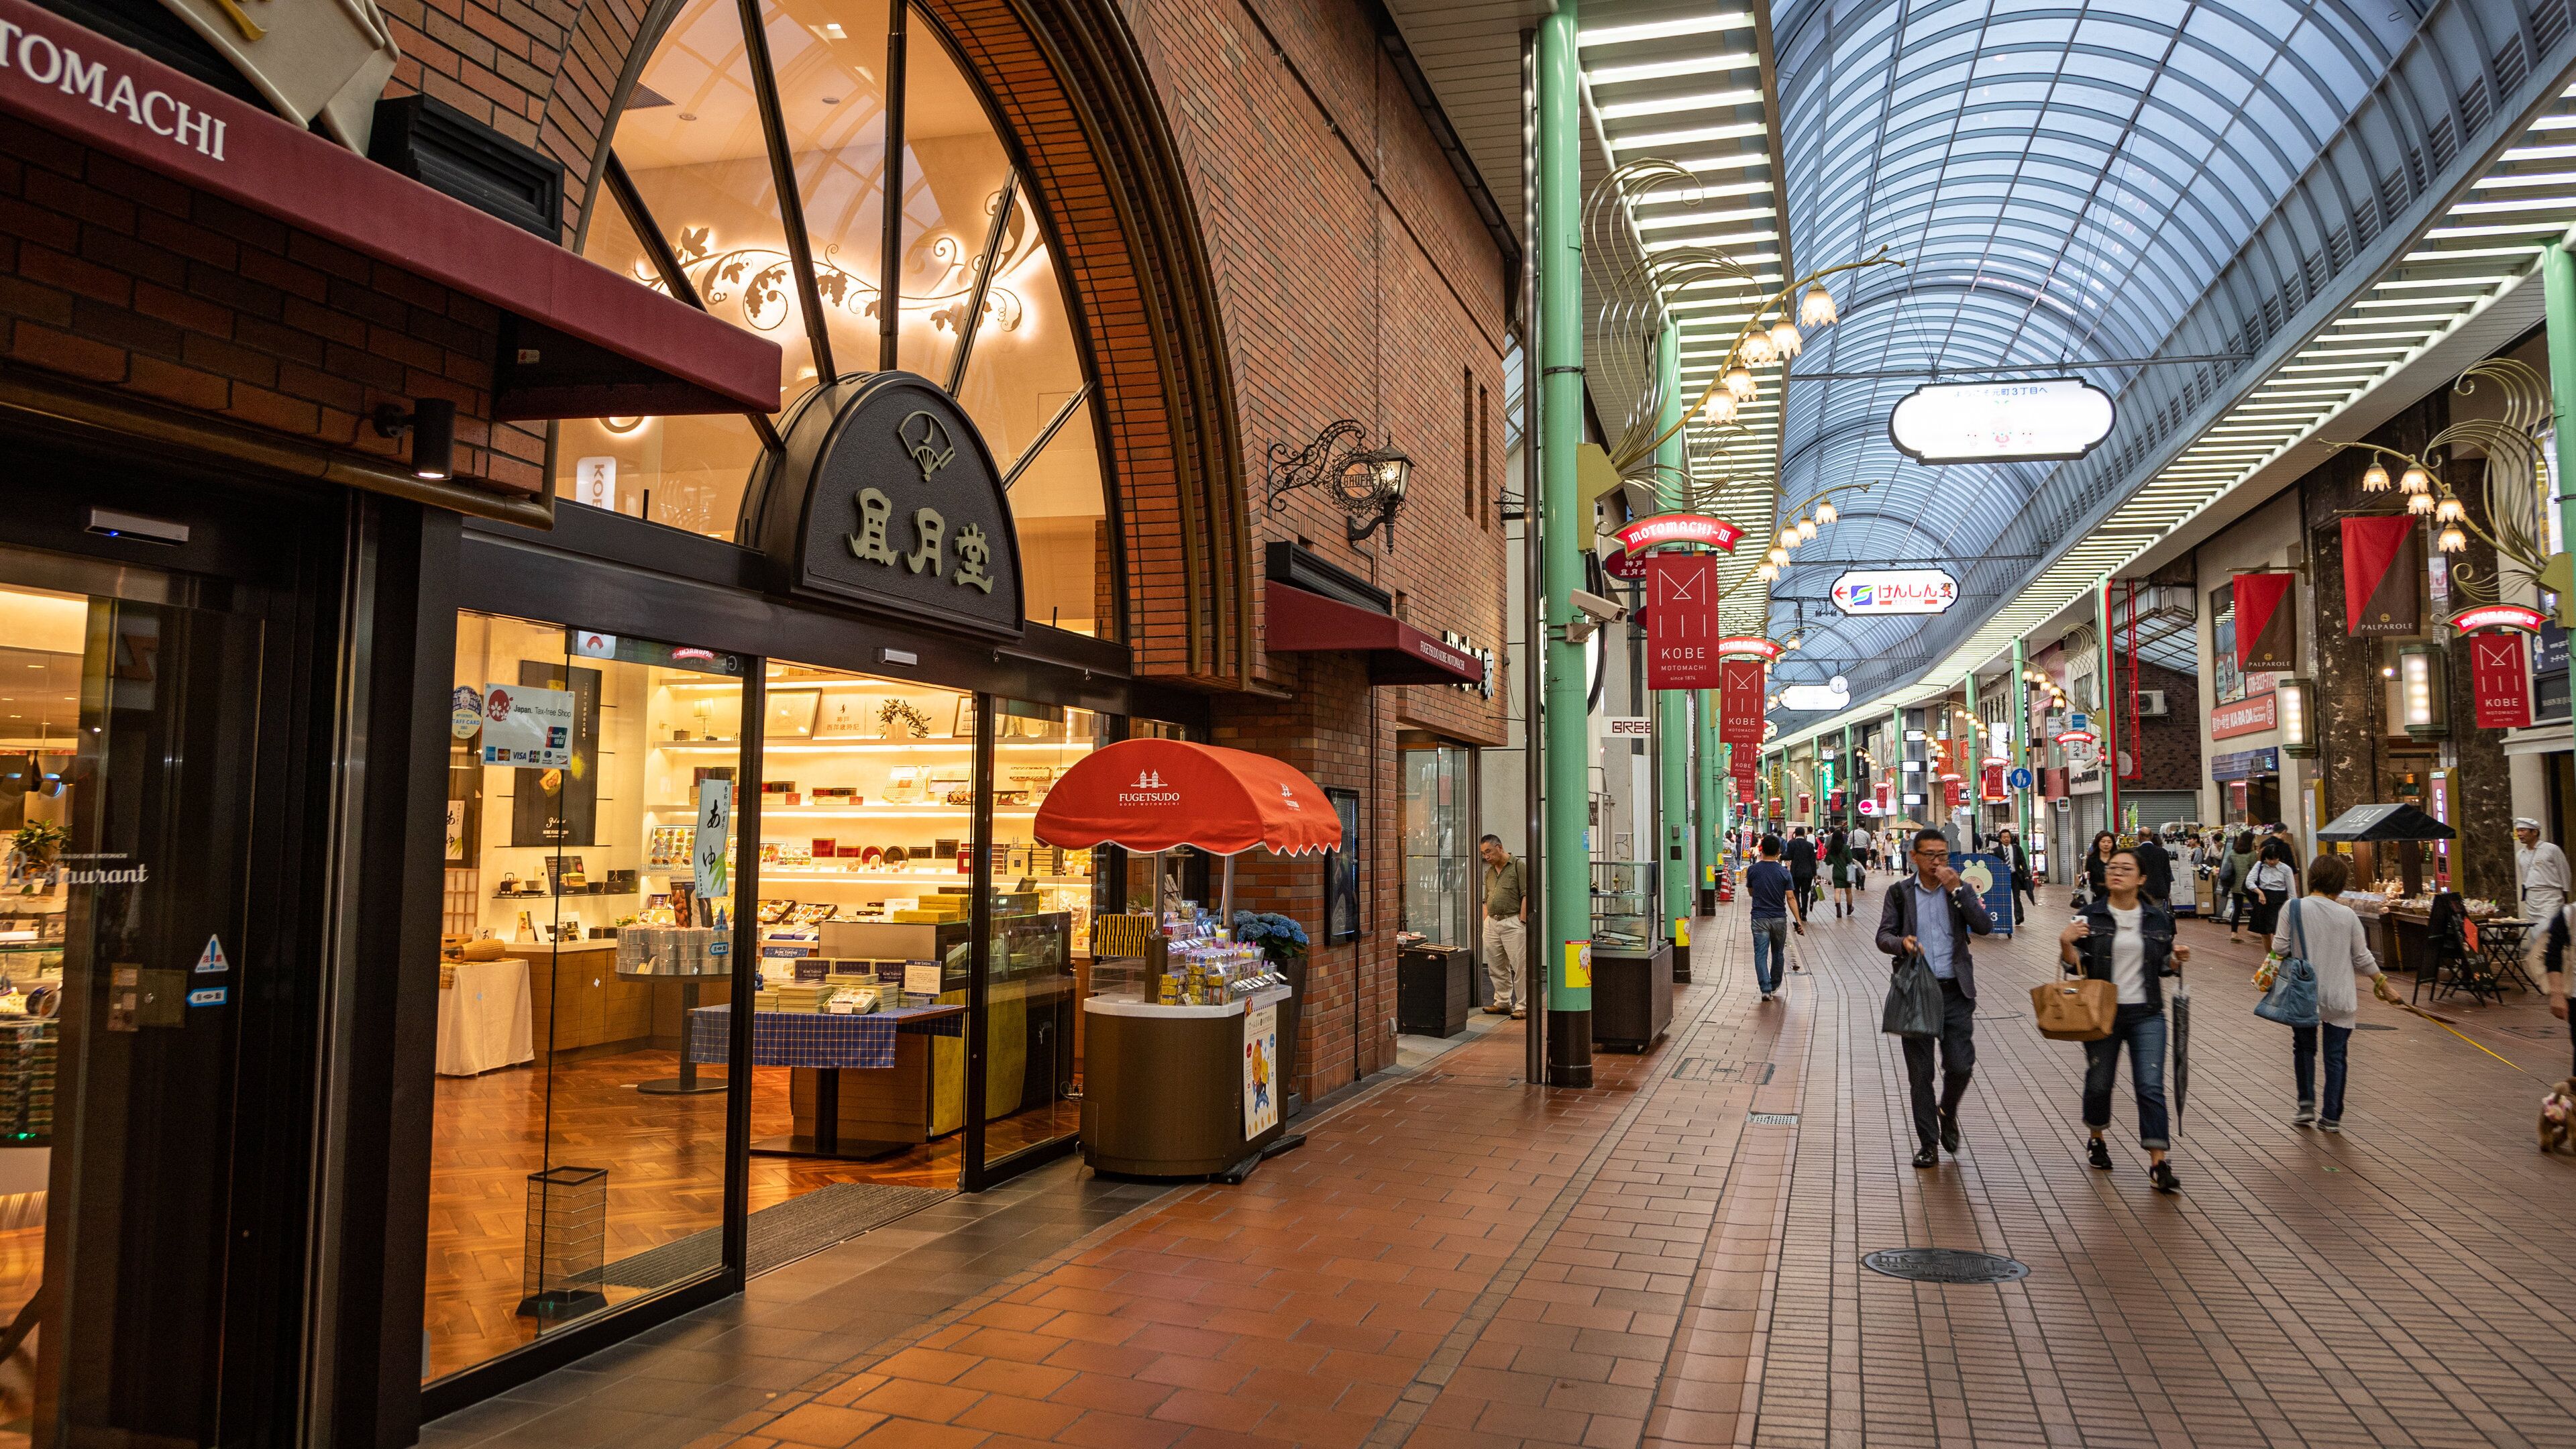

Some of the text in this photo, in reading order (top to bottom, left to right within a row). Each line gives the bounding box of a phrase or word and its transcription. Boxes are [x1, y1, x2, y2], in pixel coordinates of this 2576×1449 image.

[1879, 584, 1937, 598] けんしん
[1662, 647, 1705, 659] KOBE
[2485, 698, 2519, 707] KOBE
[514, 705, 572, 718] Japan. Tax-free Shop
[1729, 718, 1756, 726] KOBE
[513, 752, 527, 760] VISA
[1119, 792, 1180, 802] FUGETSUDO
[703, 799, 721, 875] あゆ
[2, 851, 150, 889] Restaurant
[1990, 911, 1998, 922] 3
